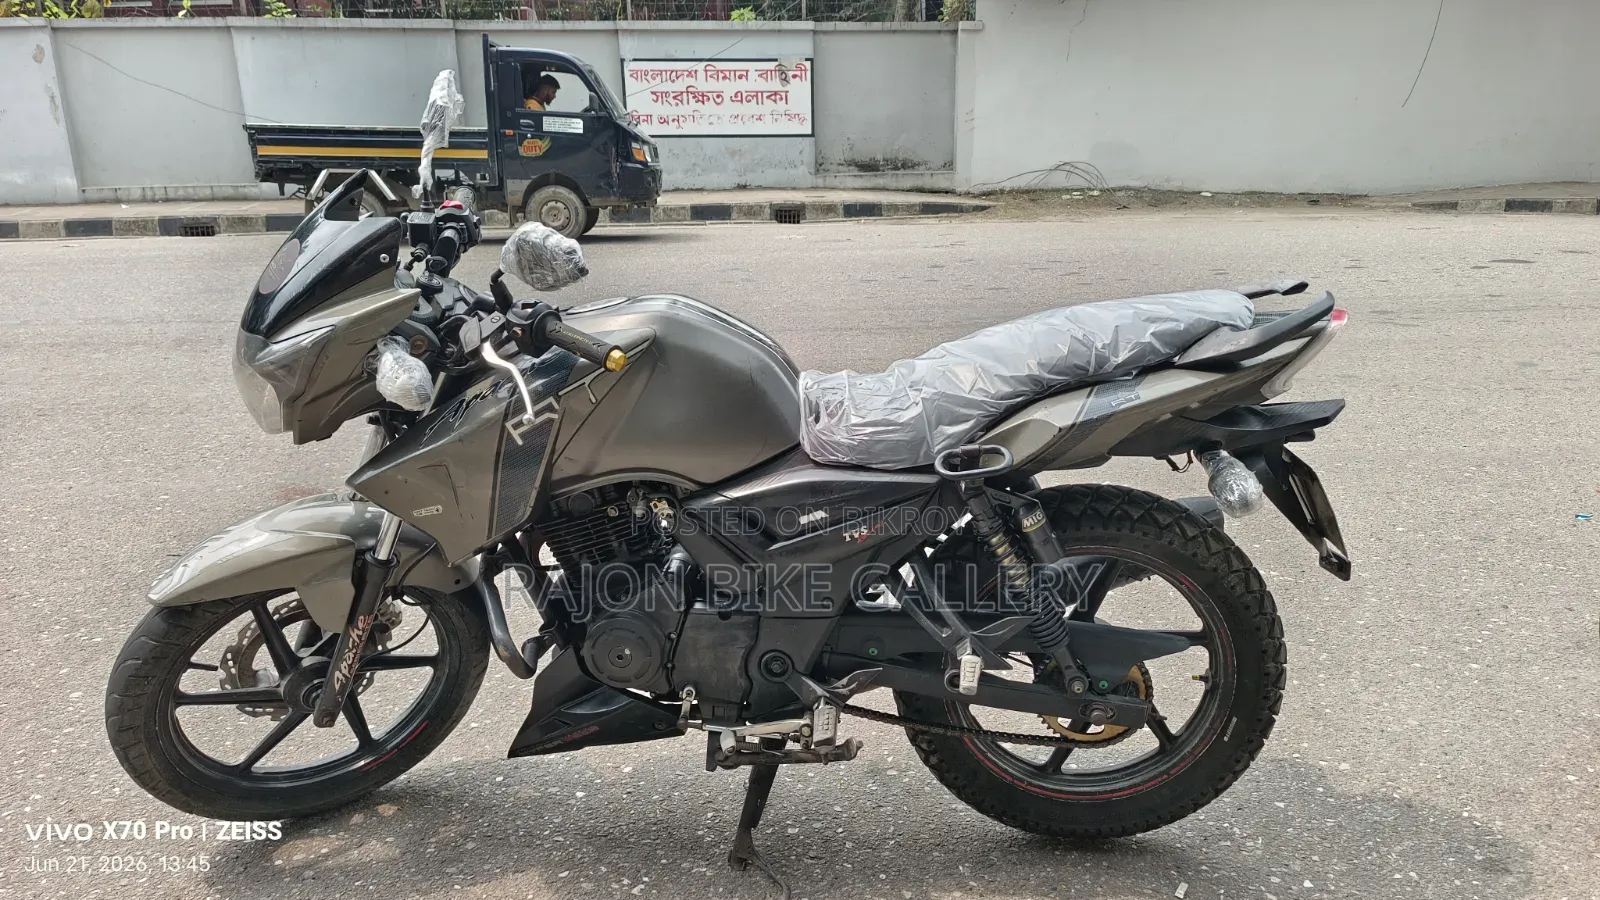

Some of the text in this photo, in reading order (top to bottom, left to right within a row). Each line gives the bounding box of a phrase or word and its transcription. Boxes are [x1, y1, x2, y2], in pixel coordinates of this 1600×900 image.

[628, 66, 698, 83] বাংলাদেশ
[703, 64, 749, 82] বিমান
[651, 86, 789, 107] সংরক্ষিত এলাকা
[523, 144, 543, 153] DUTY
[1023, 511, 1043, 528] MIG
